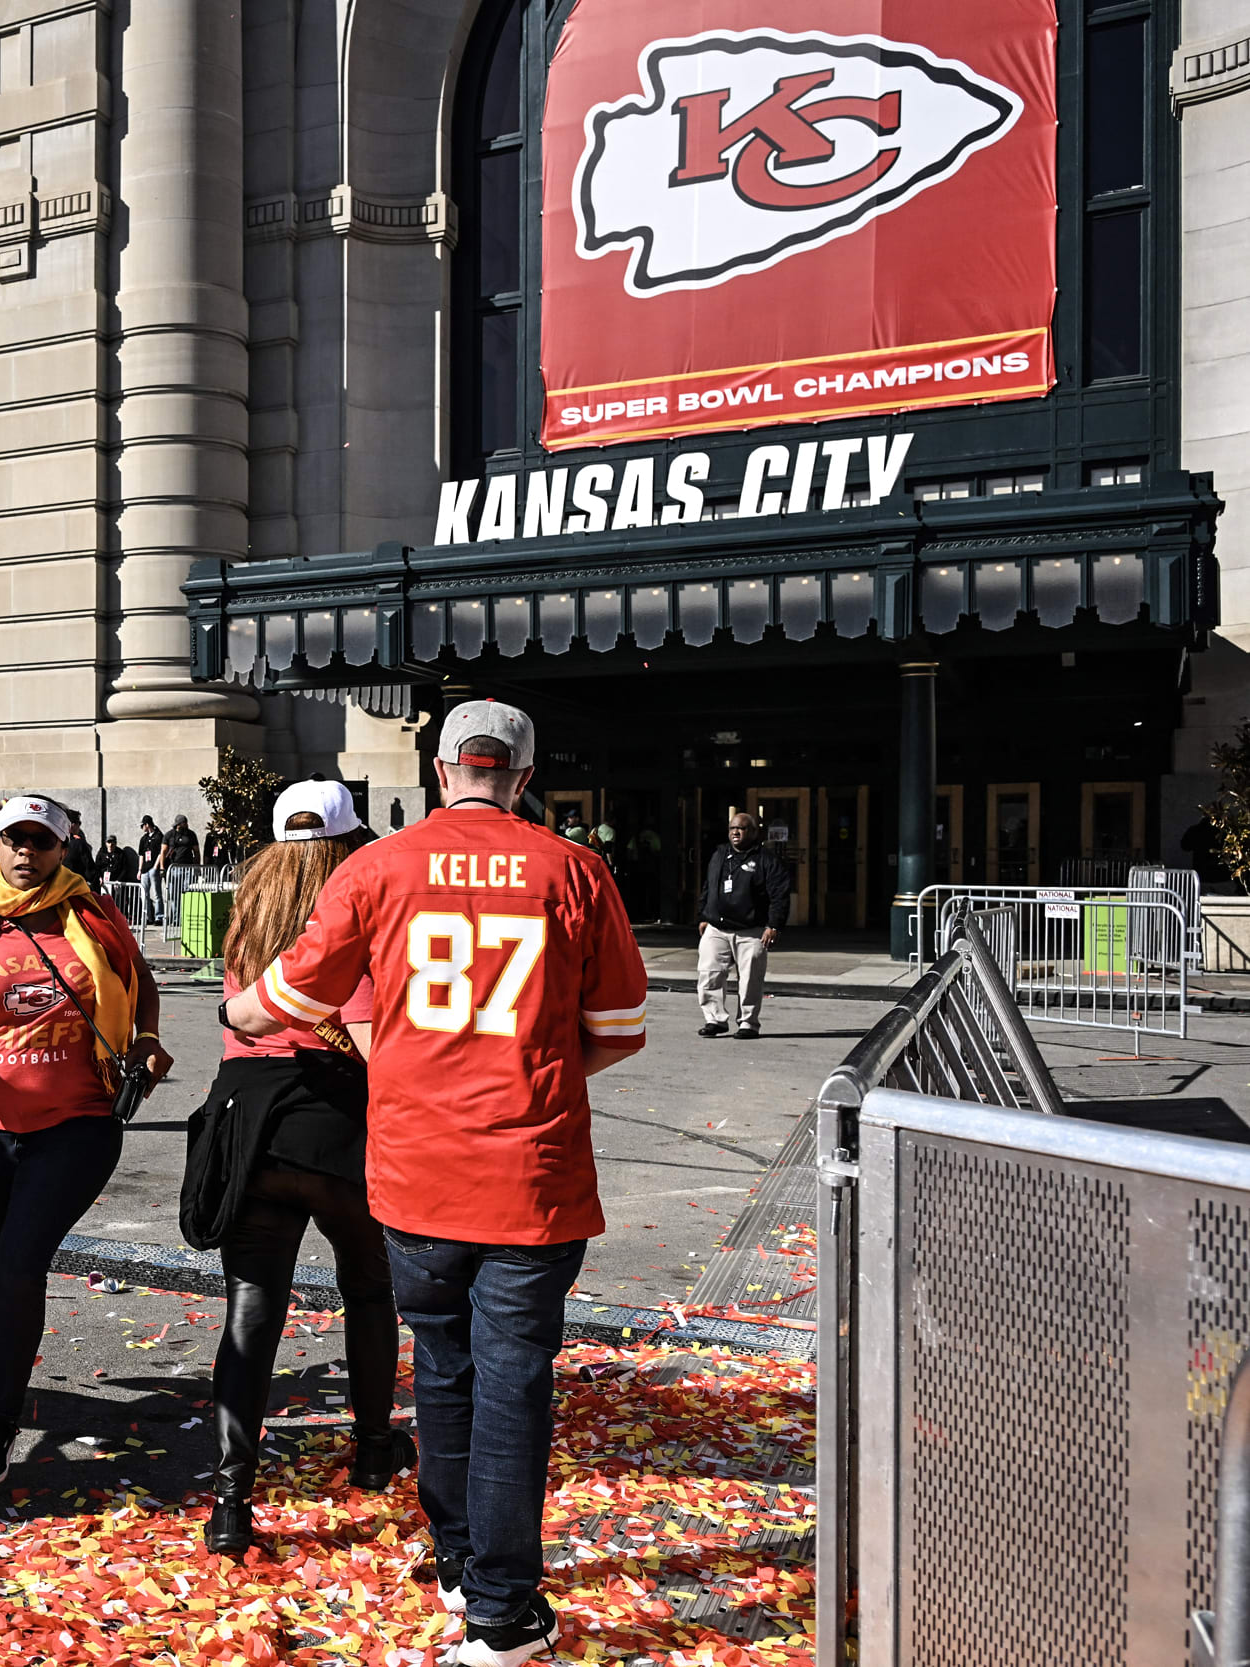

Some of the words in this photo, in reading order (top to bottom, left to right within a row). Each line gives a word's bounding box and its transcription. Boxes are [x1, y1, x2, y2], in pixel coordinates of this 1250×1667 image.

[668, 67, 902, 212] KC
[560, 396, 668, 426] SUPER
[678, 383, 783, 412] BOWL
[793, 352, 1030, 396] CHAMPIONS
[433, 452, 710, 546] KANSAS
[738, 433, 915, 519] CITY
[428, 853, 527, 888] KELCE
[1047, 904, 1078, 912] NATIONAL
[406, 911, 547, 1037] 87
